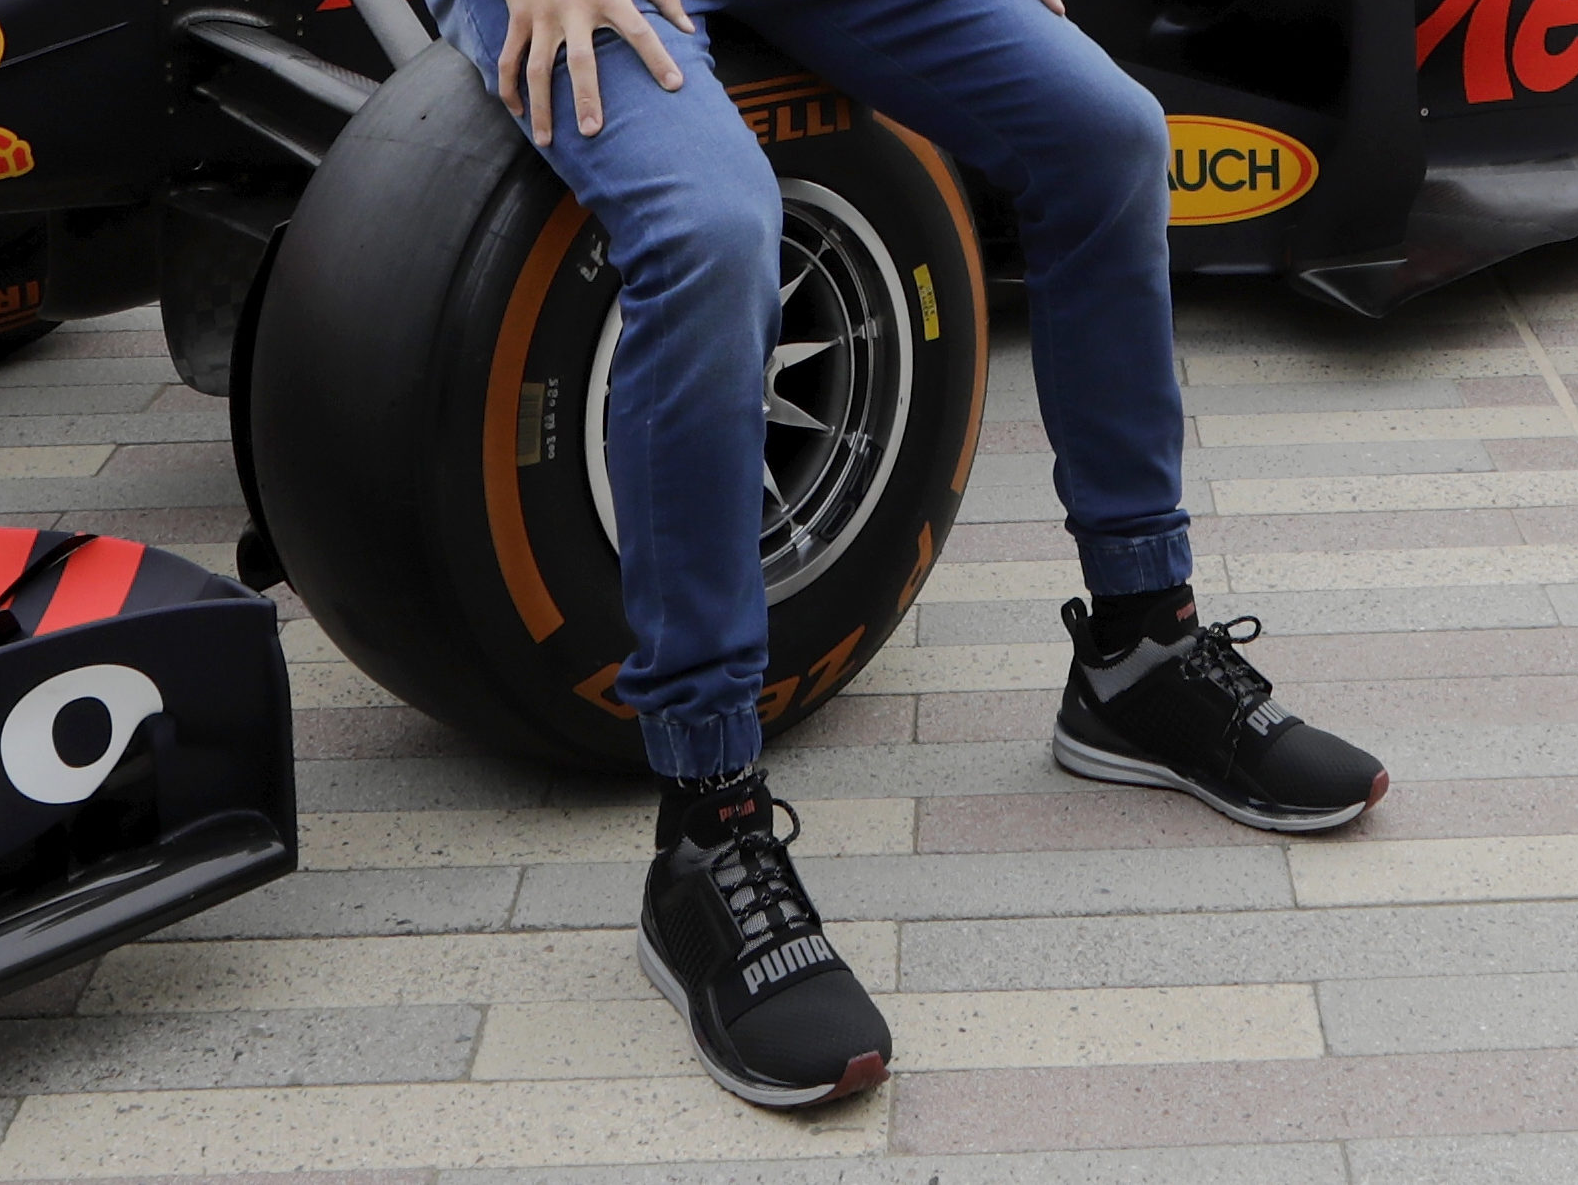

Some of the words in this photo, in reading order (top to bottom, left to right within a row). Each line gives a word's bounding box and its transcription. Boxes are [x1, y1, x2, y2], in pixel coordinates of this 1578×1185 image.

[738, 90, 851, 145] ELLI
[1169, 148, 1280, 192] UCH
[742, 934, 834, 996] PUMA
